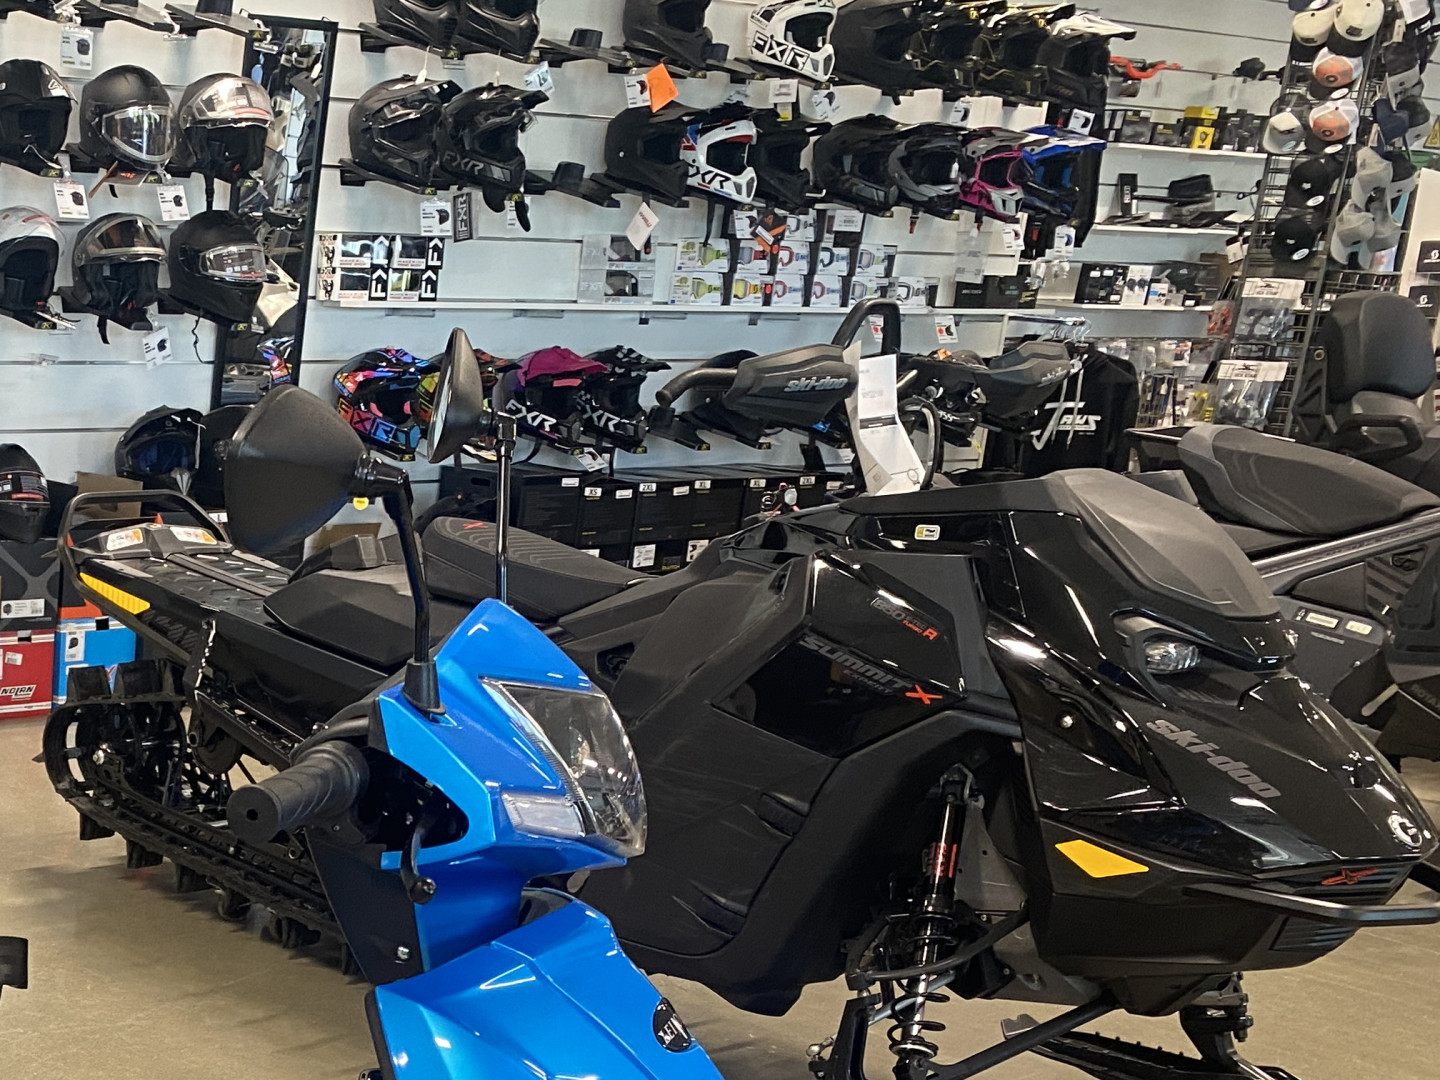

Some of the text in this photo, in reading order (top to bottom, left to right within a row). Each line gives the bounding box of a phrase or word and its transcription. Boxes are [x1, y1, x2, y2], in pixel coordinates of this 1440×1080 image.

[753, 31, 810, 71] FXR
[443, 151, 484, 175] FXR
[784, 376, 849, 392] ski-doo
[506, 399, 557, 432] FXR
[589, 488, 598, 496] XS
[642, 483, 655, 491] 2XL
[216, 514, 223, 523] L
[921, 628, 938, 641] R
[798, 633, 944, 705] SUMMIT X
[0, 685, 35, 697] NOLAN
[1146, 719, 1282, 798] ski-doo
